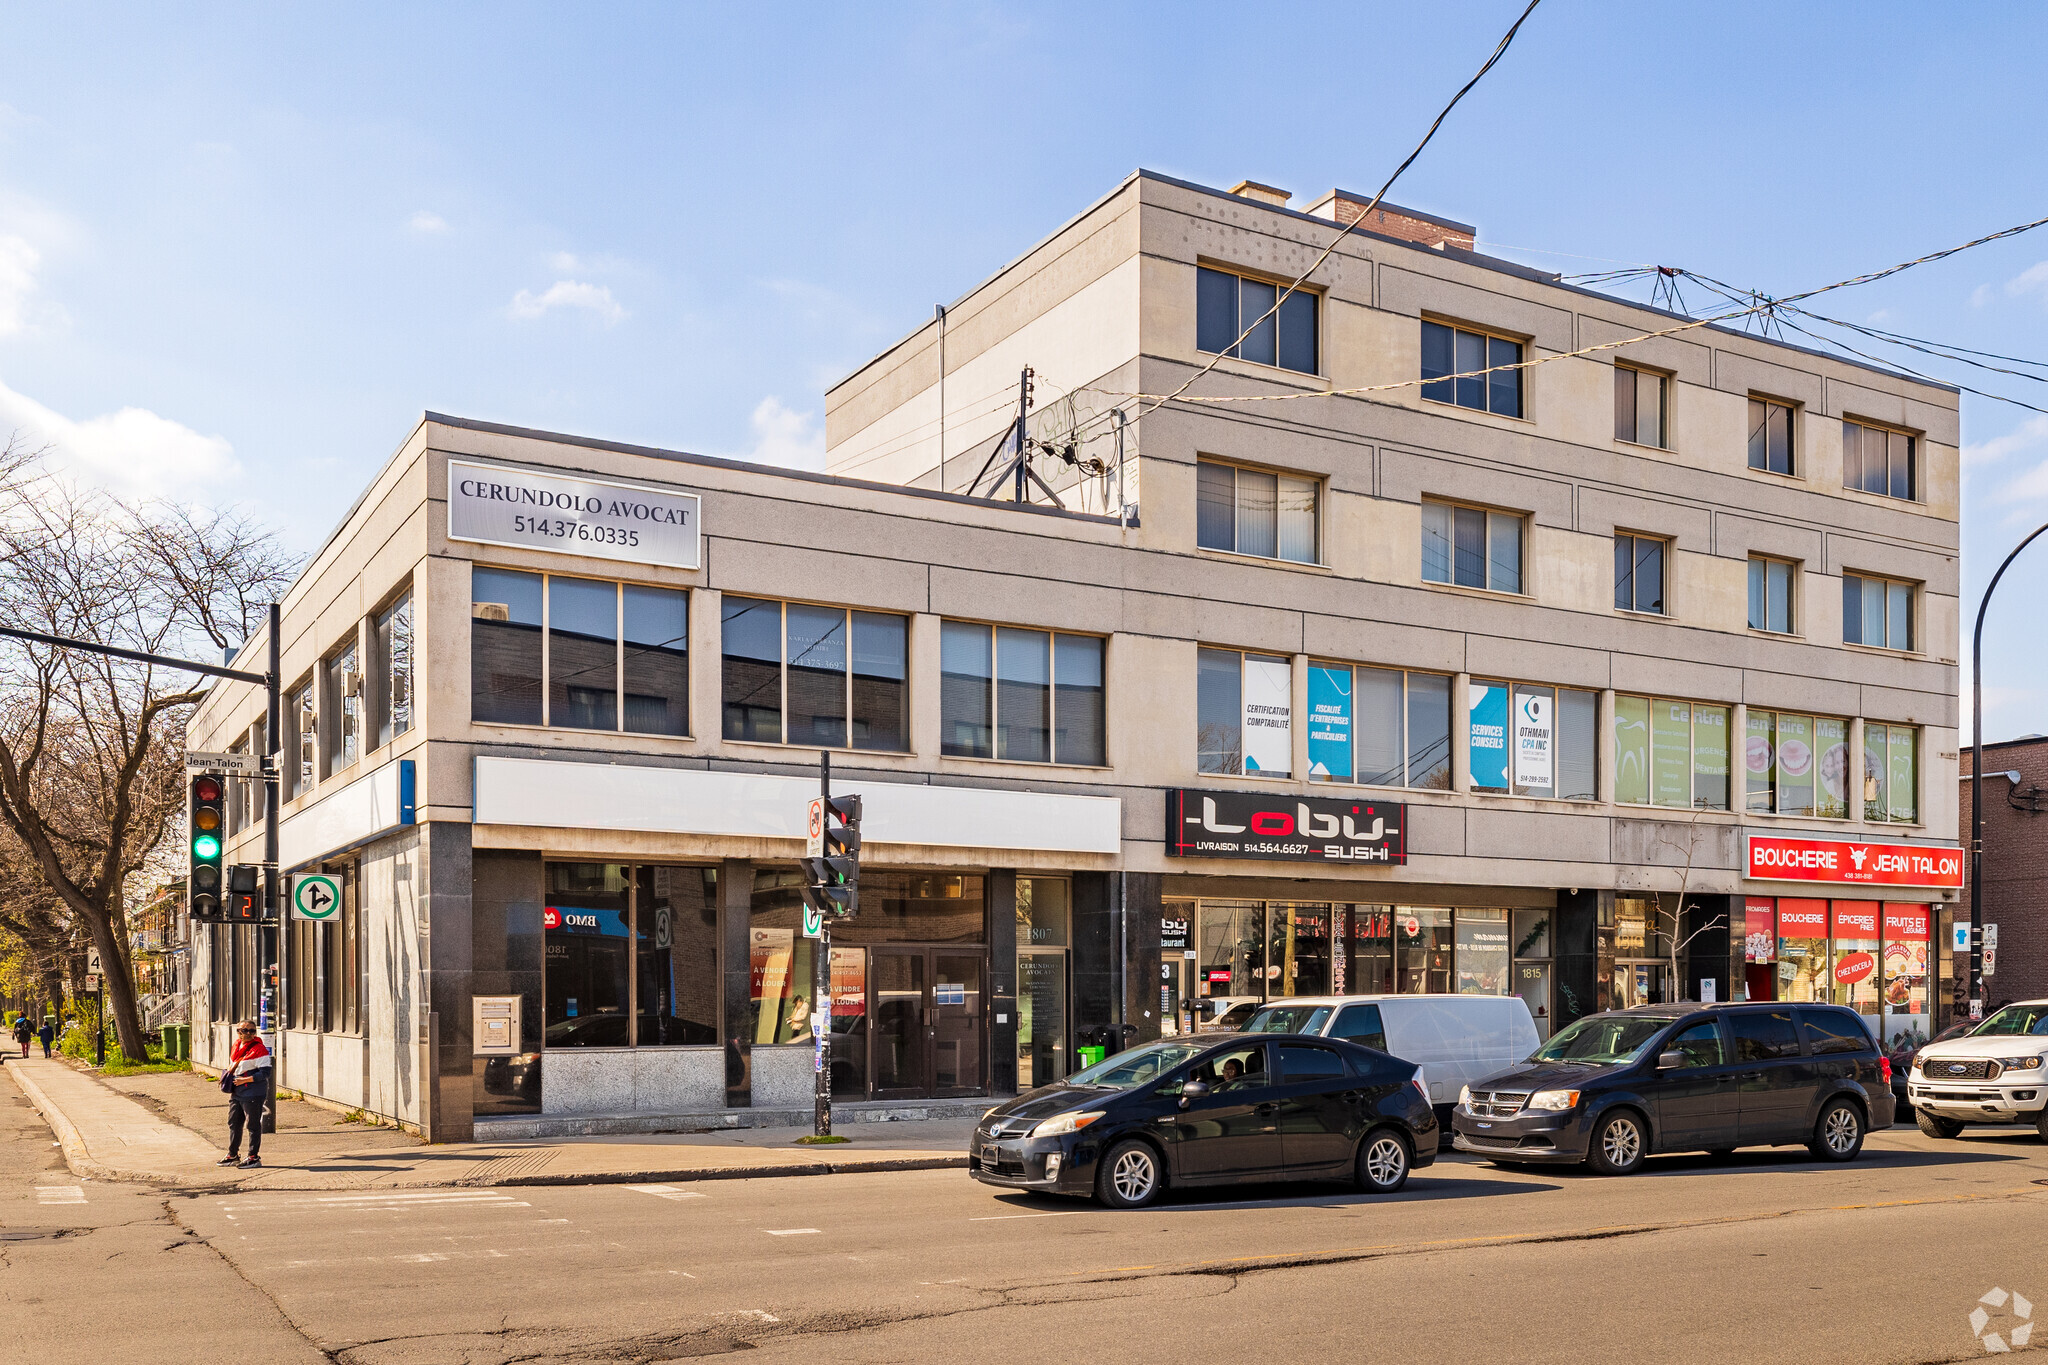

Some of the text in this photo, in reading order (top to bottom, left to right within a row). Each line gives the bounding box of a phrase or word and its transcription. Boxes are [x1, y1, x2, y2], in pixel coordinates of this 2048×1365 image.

[460, 480, 689, 526] CERUNDOLO AVOCAT
[514, 515, 639, 547] 514.376.0335
[1247, 704, 1290, 716] CERTIFICATION
[1315, 704, 1342, 714] FISCALITÉ
[1247, 717, 1289, 729] COMPTABILITÉ
[1309, 714, 1349, 725] D'ENTREPRISES
[1471, 724, 1503, 737] SERVICES
[1670, 706, 1724, 726] Centre
[1868, 727, 1910, 746] Fabre
[1311, 731, 1347, 742] PARTICULIERS
[1520, 727, 1549, 738] OTHMANI
[1471, 736, 1503, 749] CONSEILS
[1522, 739, 1547, 750] CPA INC
[1694, 747, 1728, 758] URGENCE
[186, 757, 243, 768] Jean-Talon
[1695, 762, 1729, 775] DENTAIRE
[1196, 841, 1308, 854] LIVRAISON 514.564.6627
[1754, 847, 1958, 875] BOUCHERIE JEAN TALON
[242, 896, 252, 917] 2
[1782, 913, 1824, 924] BOUCHERIE
[1838, 912, 1874, 925] ÉPICERIES
[1886, 916, 1926, 928] FRUITS ET
[1026, 928, 1052, 940] 1807
[1903, 926, 1926, 934] LÉGUMES
[1522, 968, 1541, 978] 1815
[1837, 967, 1851, 978] CHEZ
